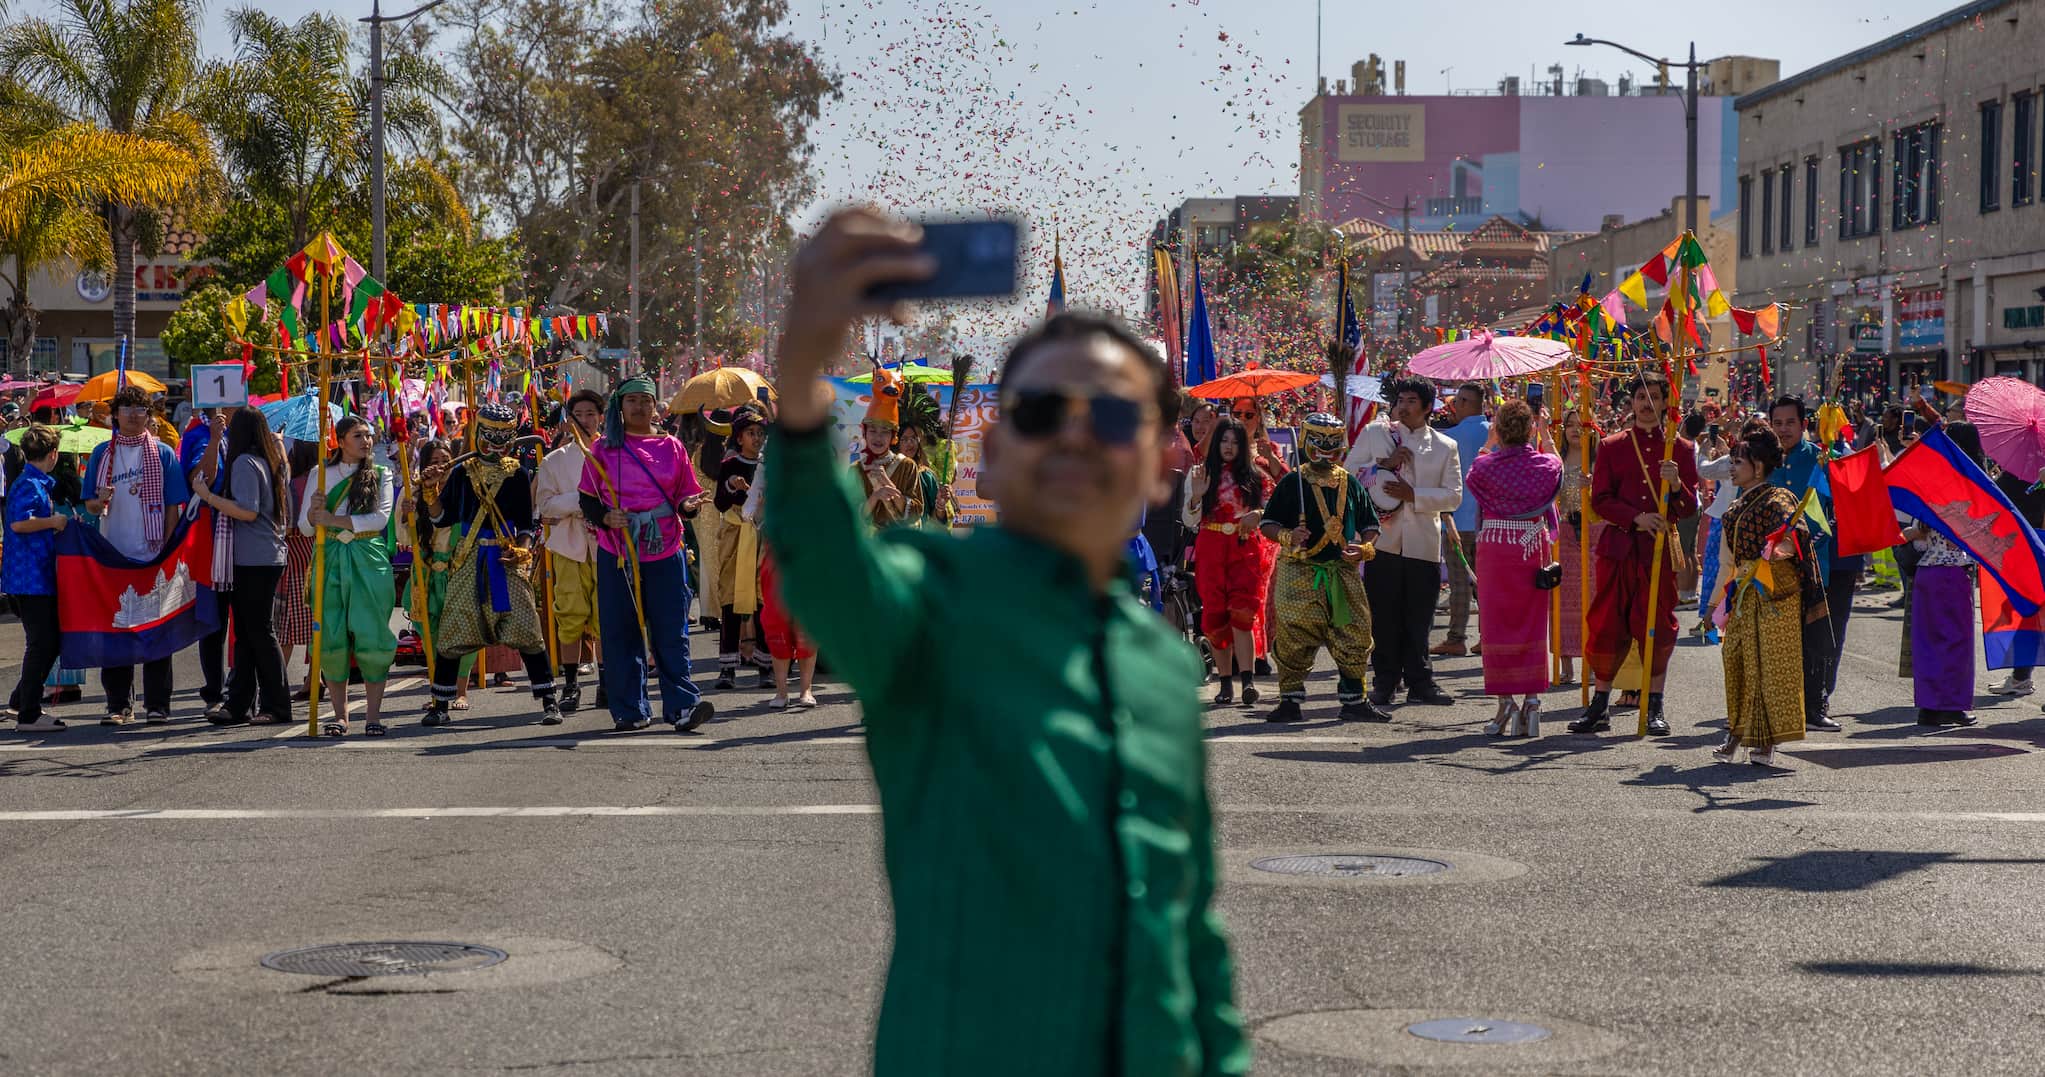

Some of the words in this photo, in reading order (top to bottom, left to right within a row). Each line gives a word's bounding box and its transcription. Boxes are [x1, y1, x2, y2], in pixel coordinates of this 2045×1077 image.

[1347, 113, 1411, 130] SECURITY
[1348, 131, 1409, 148] STORAGE
[213, 375, 225, 398] 1
[962, 467, 976, 479] Ne
